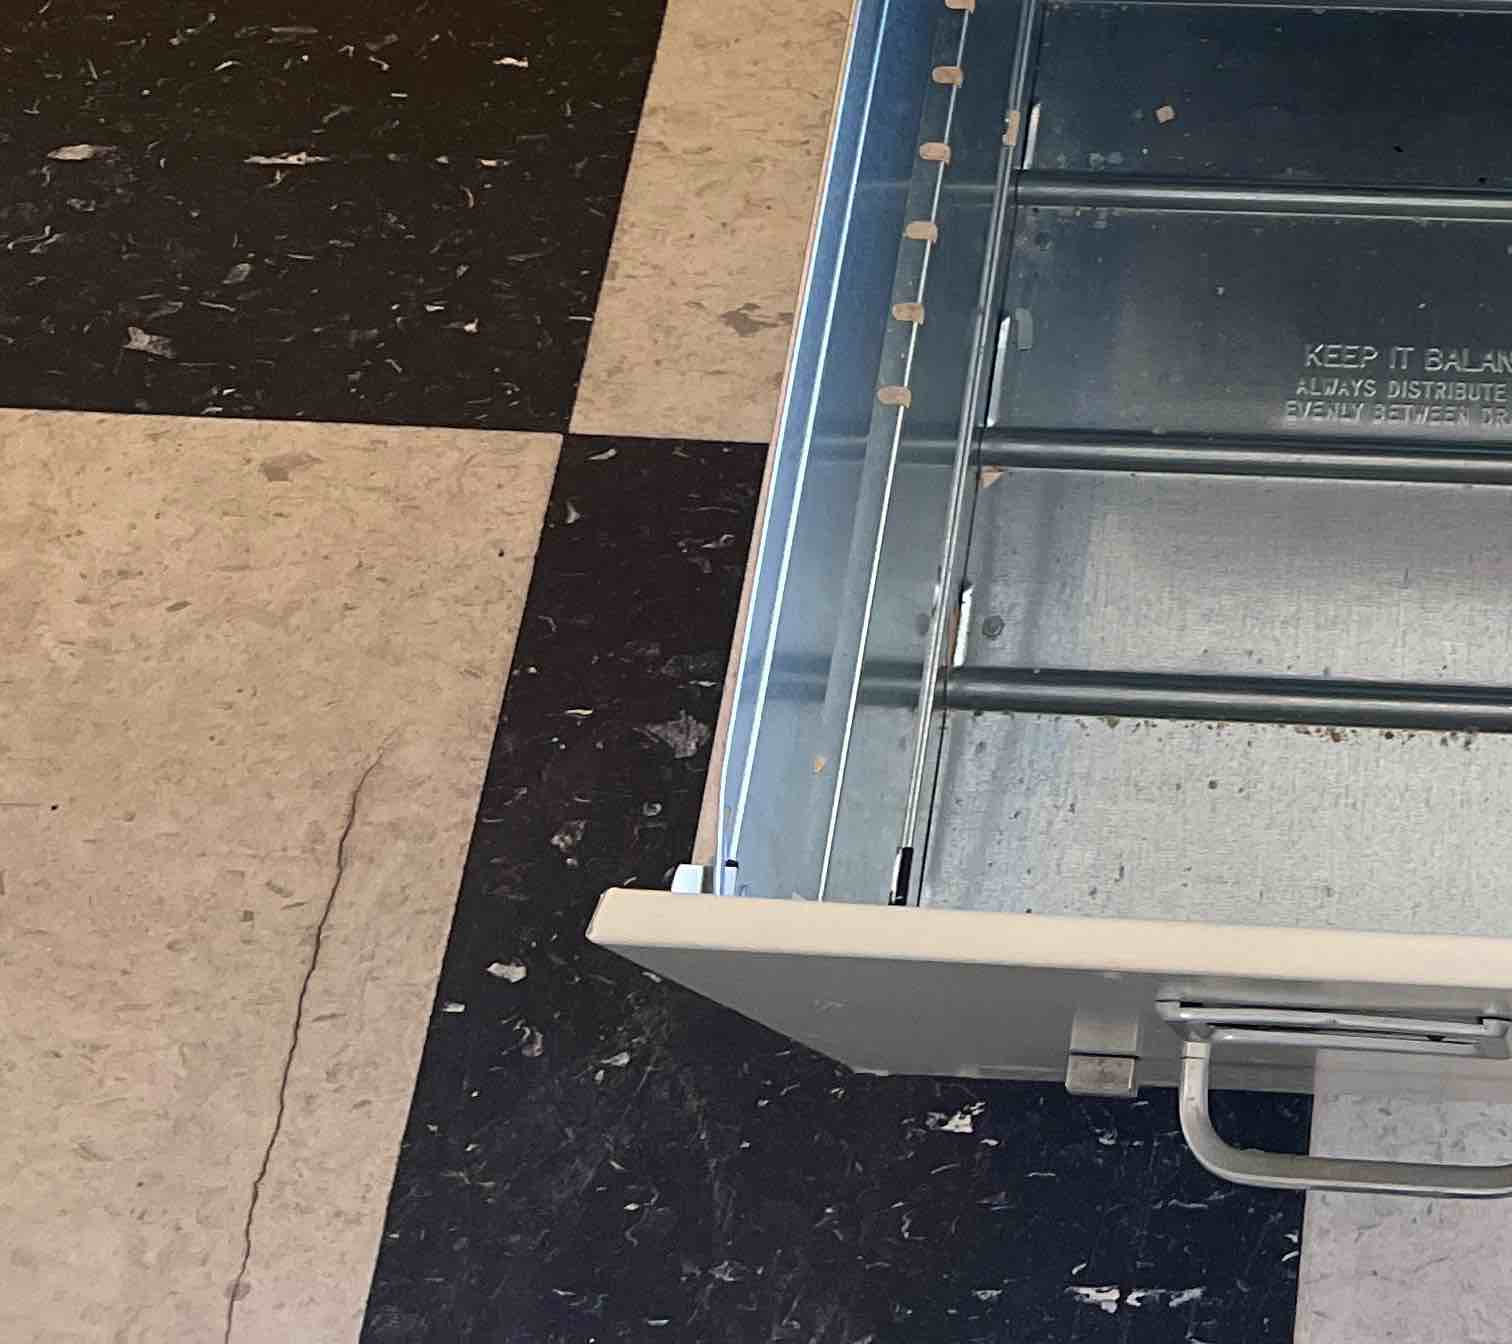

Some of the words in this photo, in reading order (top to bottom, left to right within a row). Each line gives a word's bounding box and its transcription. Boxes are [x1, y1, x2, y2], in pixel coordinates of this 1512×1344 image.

[1304, 343, 1378, 369] KEEP
[1388, 346, 1415, 370] IT
[1295, 377, 1377, 398] ALWAYS
[1386, 379, 1507, 402] DISTRIBUTE
[1285, 399, 1365, 424] EVENLY
[1373, 403, 1470, 428] BETWEEN
